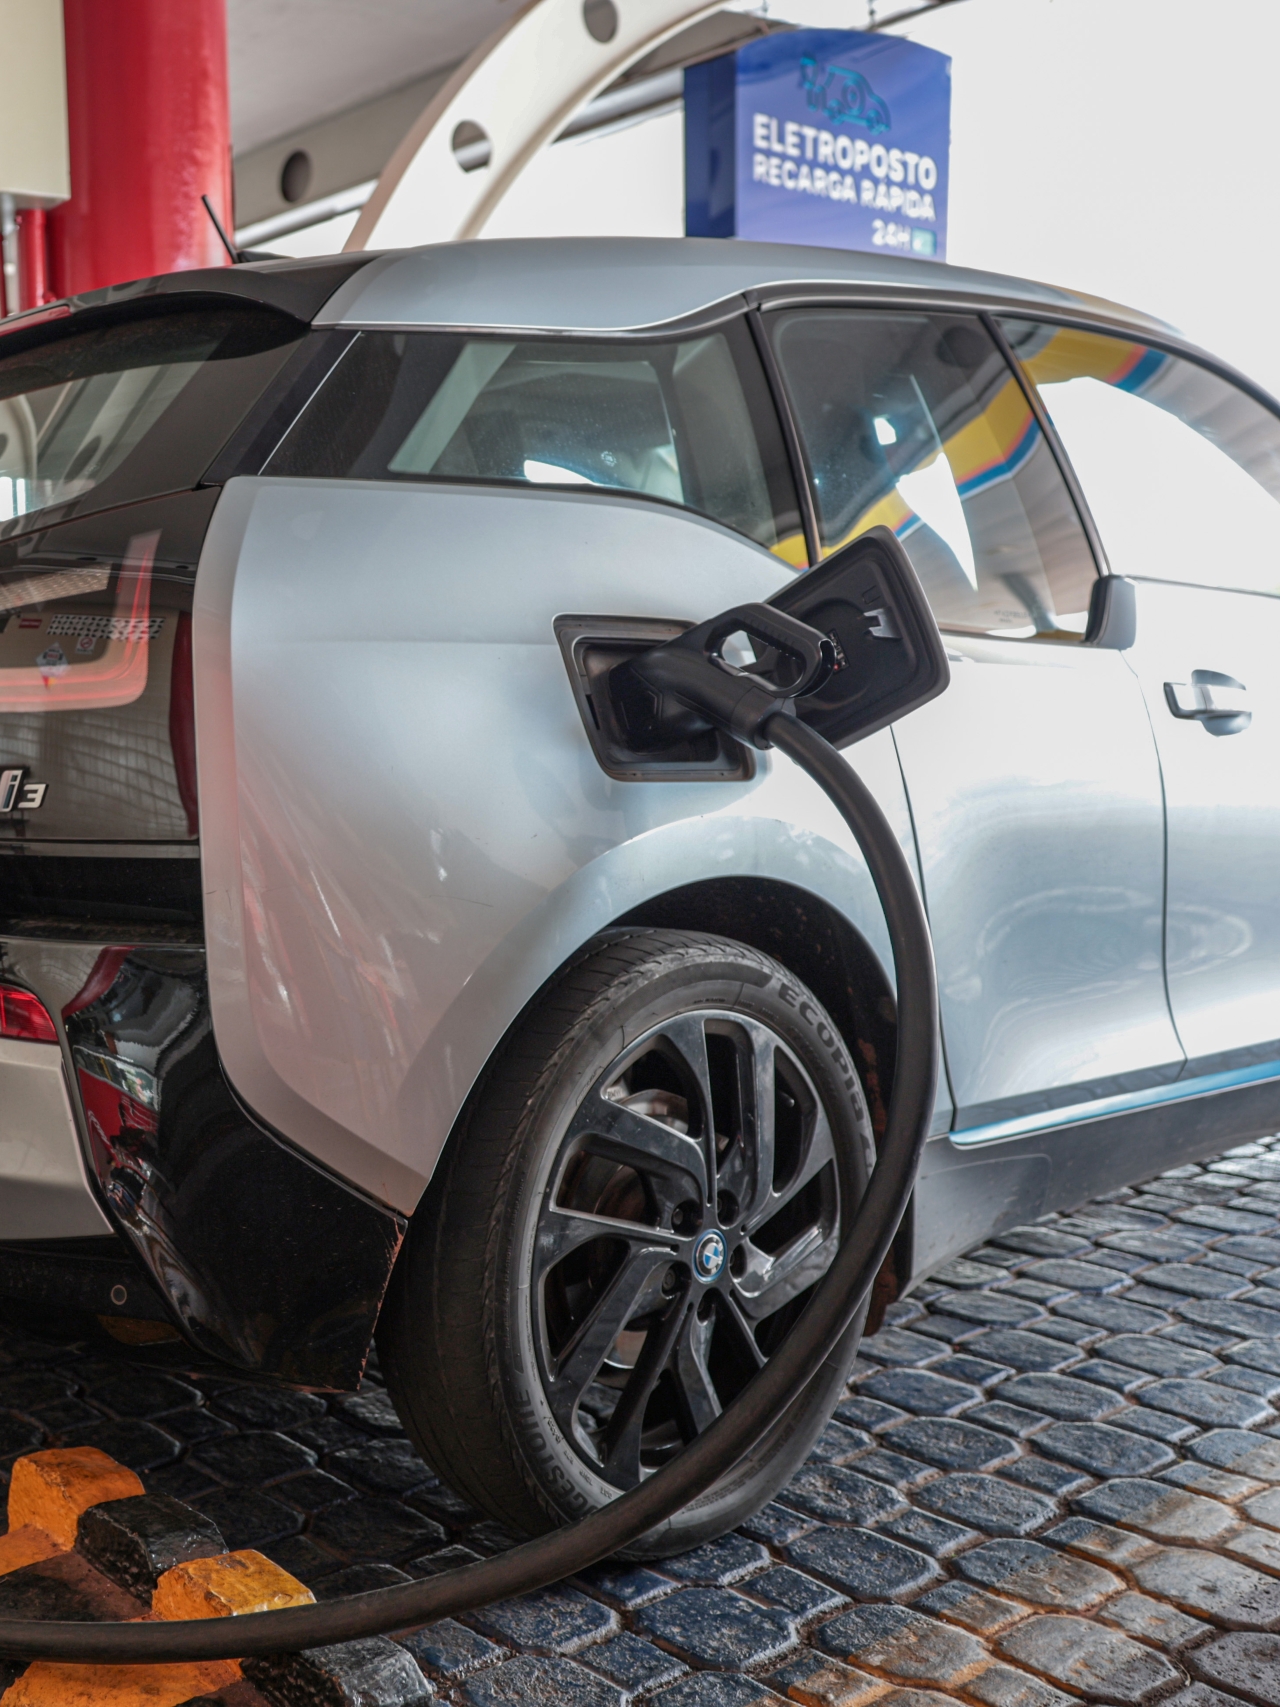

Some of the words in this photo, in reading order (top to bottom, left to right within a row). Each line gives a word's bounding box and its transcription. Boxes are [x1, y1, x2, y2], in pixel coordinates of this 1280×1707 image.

[753, 112, 937, 191] ELETROPOSTO
[753, 152, 858, 205] RECARGA
[872, 218, 911, 250] 24H
